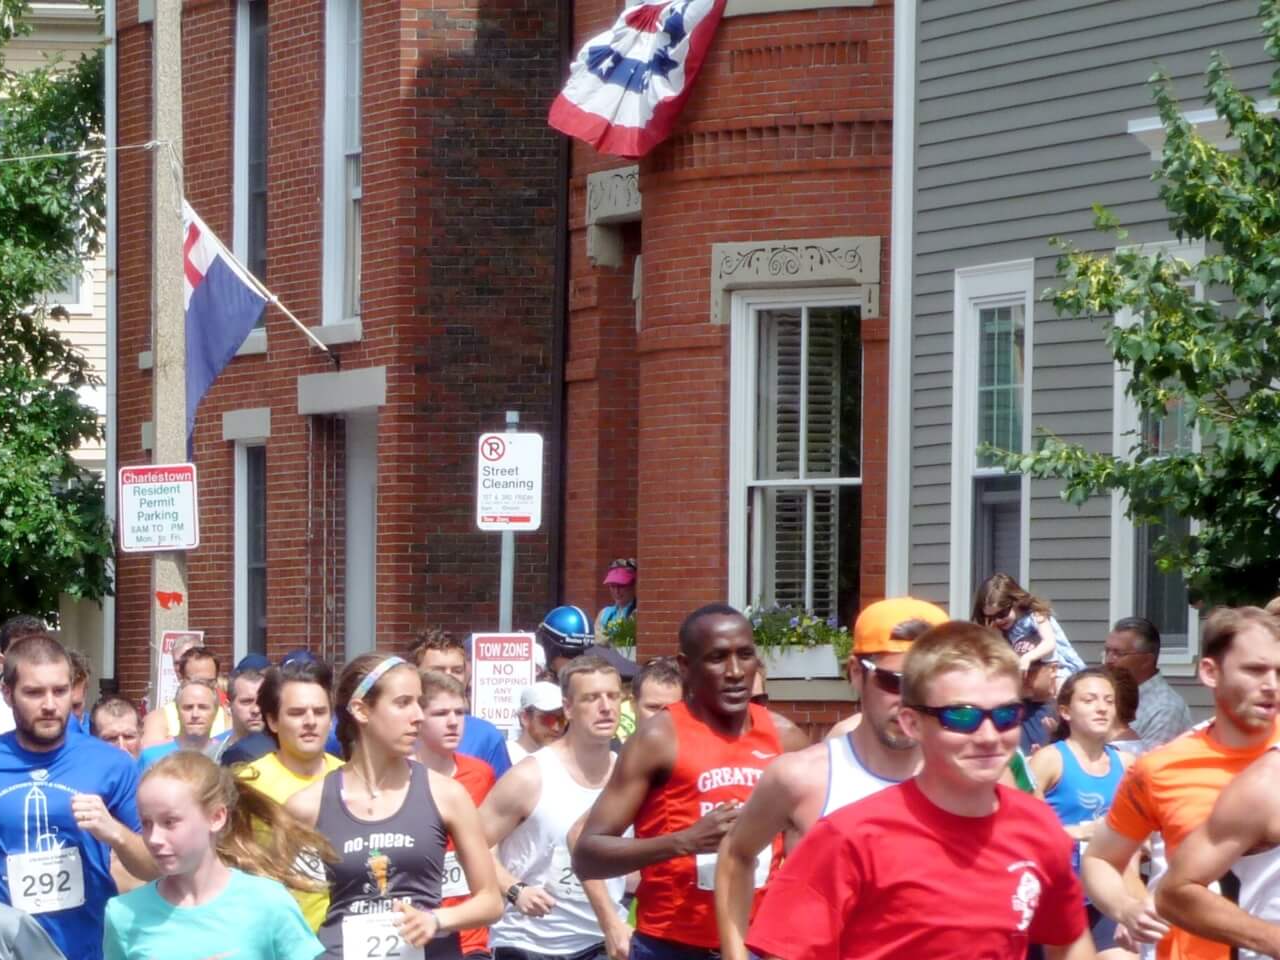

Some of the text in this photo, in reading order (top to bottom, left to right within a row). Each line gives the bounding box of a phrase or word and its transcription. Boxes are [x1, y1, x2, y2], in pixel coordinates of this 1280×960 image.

[482, 465, 519, 476] Street
[122, 471, 192, 484] Charlestown
[482, 478, 534, 490] Cleaning
[133, 484, 181, 496] Resident
[139, 497, 175, 508] Permit
[137, 510, 179, 521] Parking
[152, 524, 164, 532] TO
[170, 522, 184, 531] PM
[480, 643, 529, 657] TOW ZONE
[493, 664, 513, 675] NO
[480, 677, 528, 686] STOPPING
[481, 708, 518, 719] SUNDA
[22, 870, 72, 897] 292
[367, 935, 401, 958] 22
